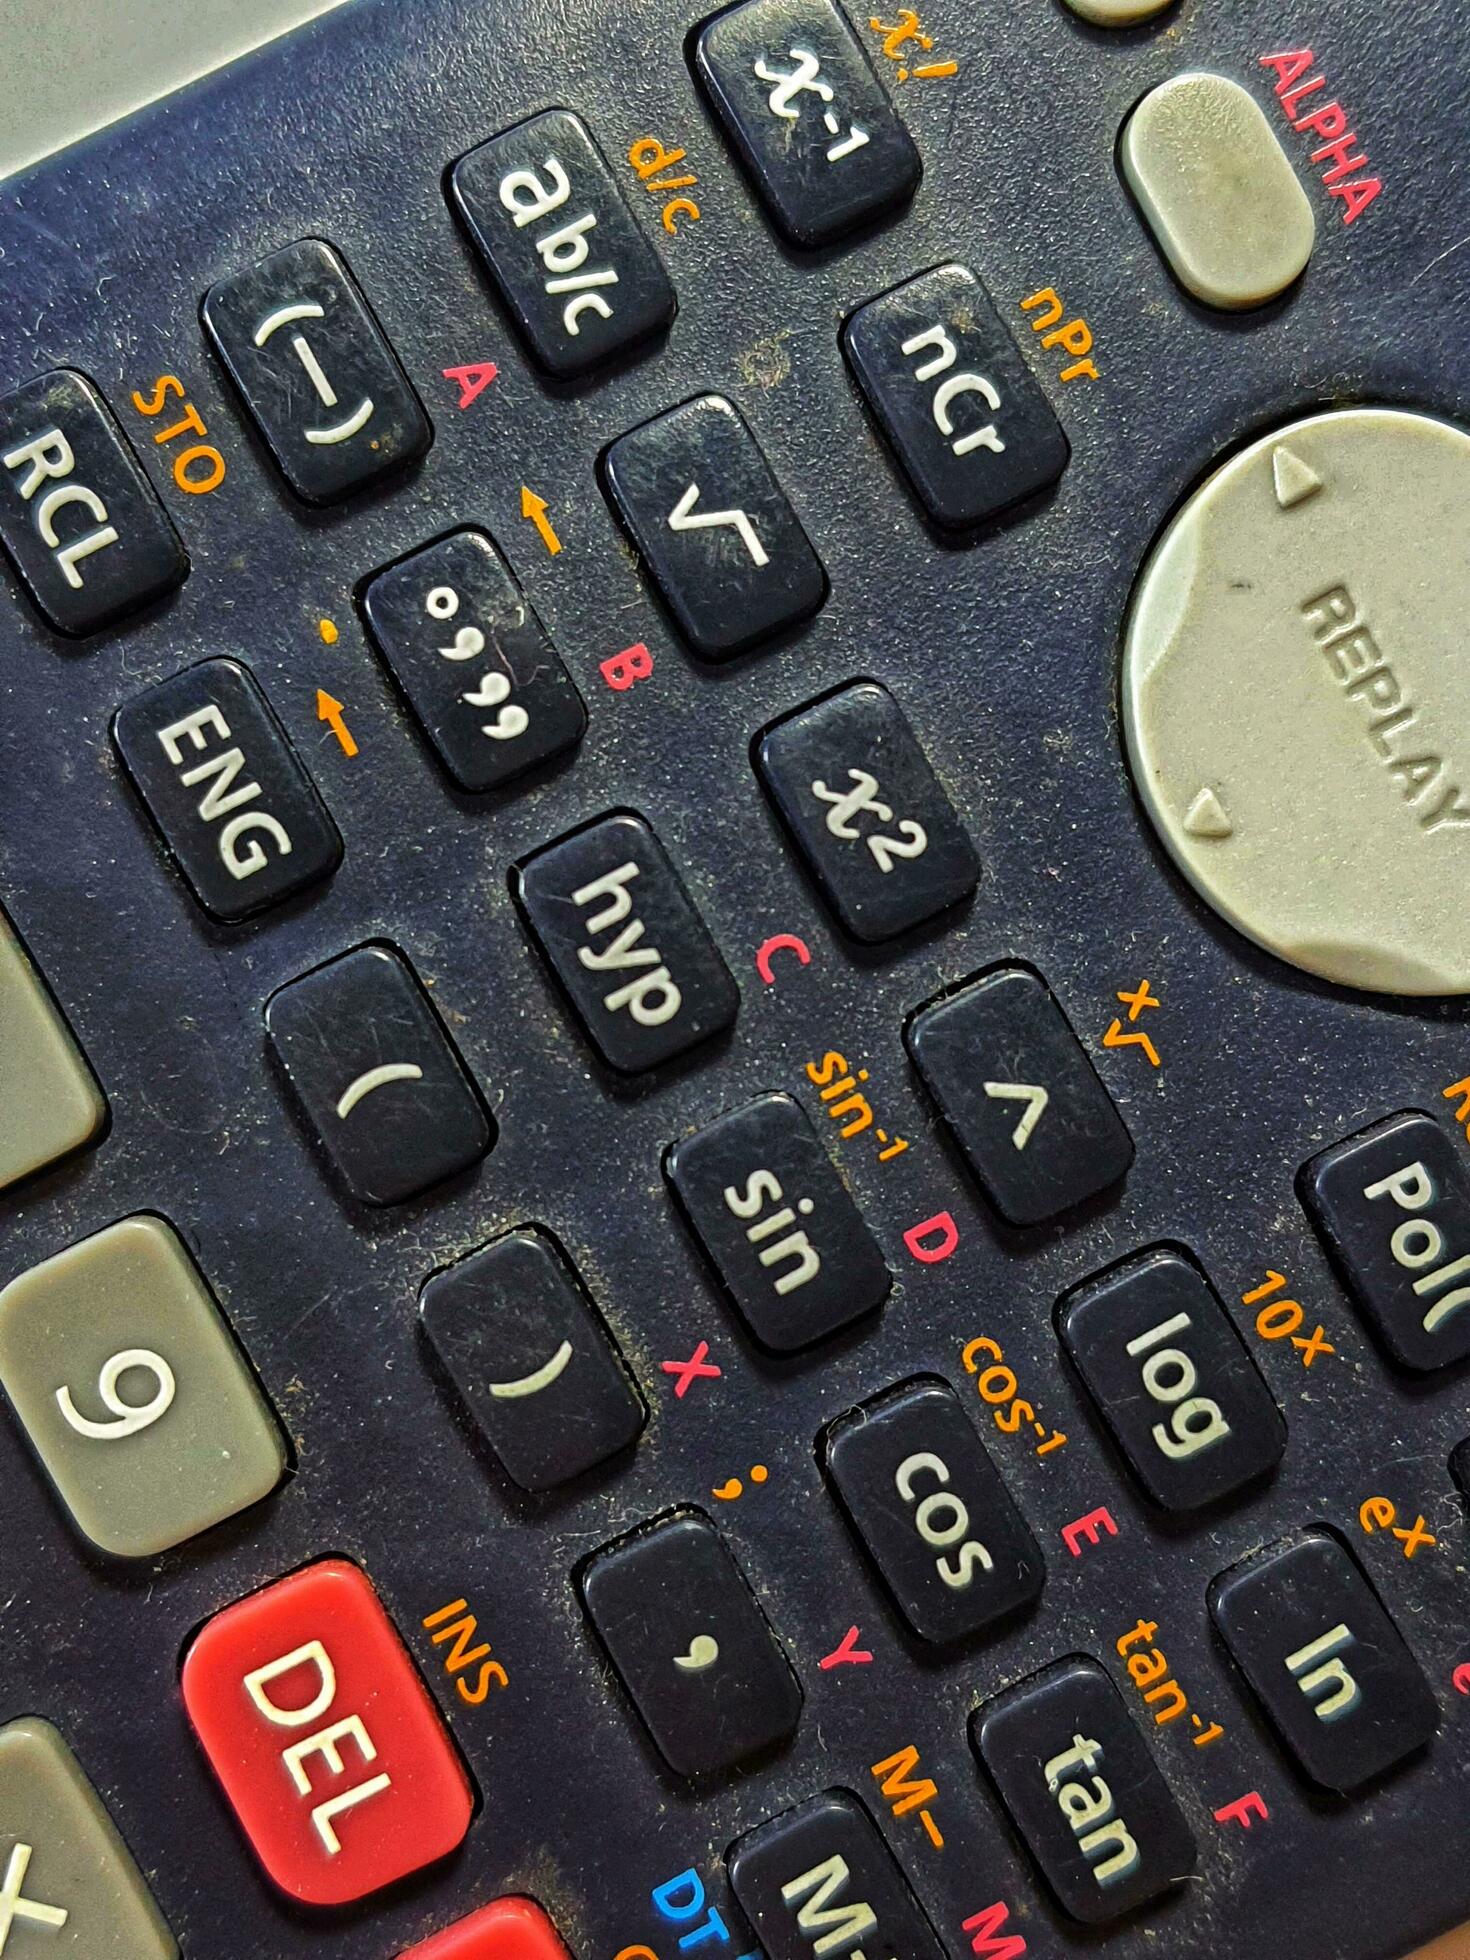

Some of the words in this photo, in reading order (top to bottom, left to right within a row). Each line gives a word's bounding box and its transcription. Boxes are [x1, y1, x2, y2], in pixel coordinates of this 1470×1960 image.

[1259, 48, 1382, 225] ALPHA
[441, 361, 498, 409] A
[1020, 287, 1100, 382] nPr
[132, 375, 226, 494] STO
[901, 323, 1007, 456] nCr
[3, 428, 119, 590] RCL
[600, 643, 653, 691] B
[157, 703, 293, 880] ENG
[571, 861, 684, 1027] hyp
[756, 934, 811, 983] C
[723, 1168, 821, 1296] sin
[903, 1211, 960, 1263] D
[55, 1348, 177, 1441] 9
[661, 1341, 722, 1398] X
[1126, 1311, 1233, 1460] log
[895, 1451, 995, 1589] cos
[1061, 1506, 1119, 1557] E
[423, 1598, 510, 1705] INS
[818, 1626, 874, 1670] Y
[242, 1638, 392, 1856] DEL
[1043, 1733, 1143, 1885] tan
[1213, 1791, 1270, 1828] F
[651, 1867, 731, 1952] DT
[961, 1900, 1028, 1960] M
